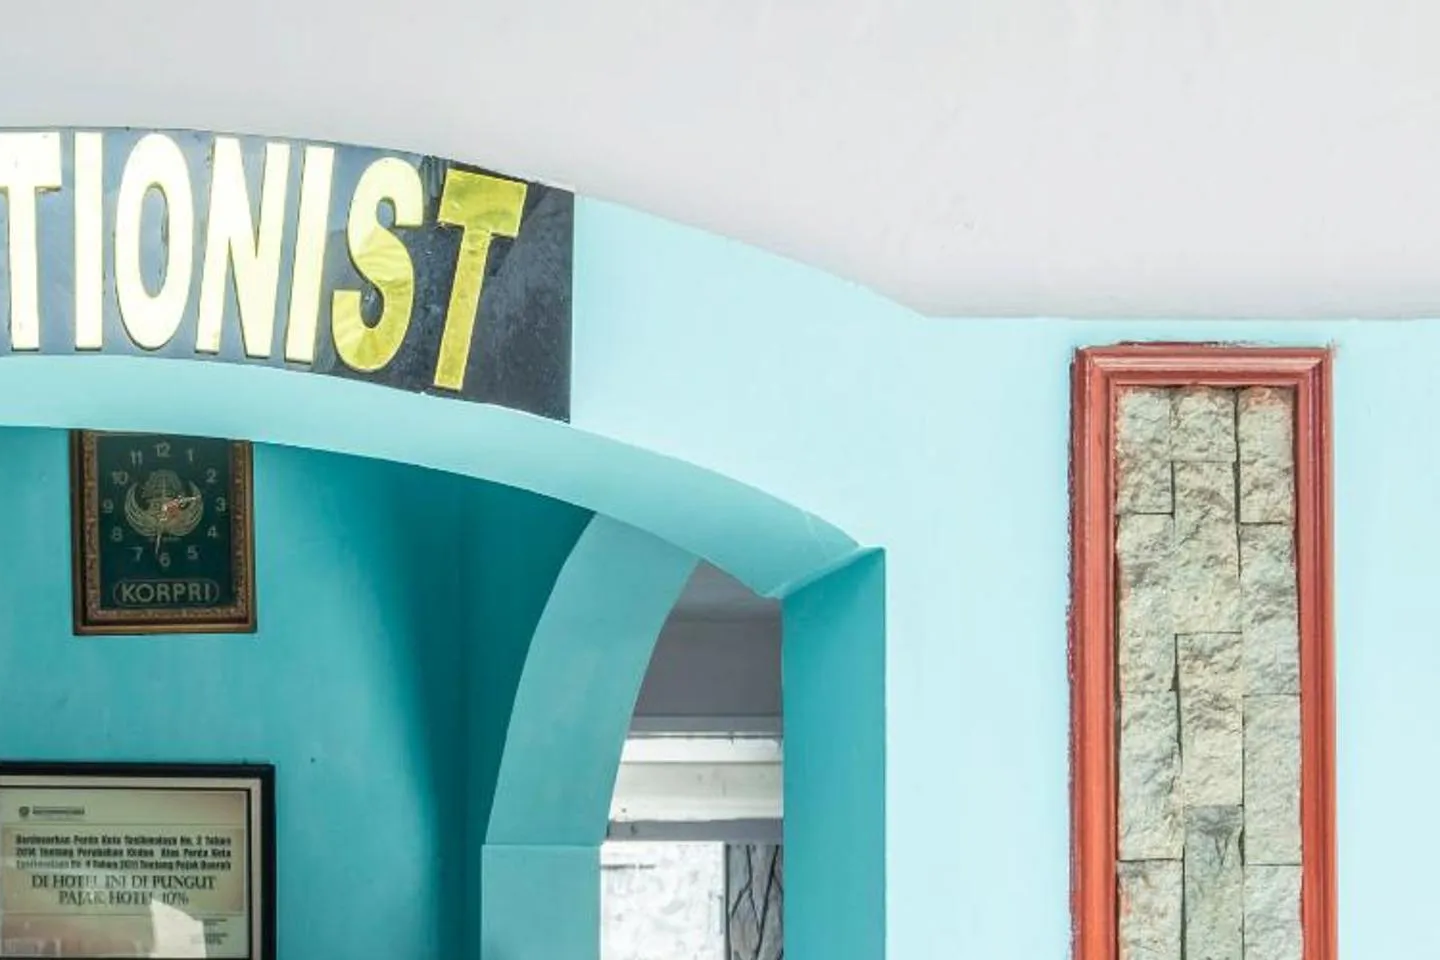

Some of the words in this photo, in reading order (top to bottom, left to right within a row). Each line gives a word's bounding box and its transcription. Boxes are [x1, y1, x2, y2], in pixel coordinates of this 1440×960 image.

[154, 442, 170, 457] 12
[186, 449, 194, 462] 1
[131, 450, 143, 466] 11
[111, 471, 129, 485] 10
[206, 469, 218, 483] 2
[102, 500, 114, 514] 9
[216, 497, 227, 512] 3
[112, 527, 123, 542] 8
[207, 525, 217, 538] 4
[131, 547, 143, 561] 7
[160, 552, 171, 567] 6
[187, 546, 199, 560] 5
[121, 583, 211, 602] KORPRI
[32, 875, 48, 888] DI
[53, 875, 100, 889] HOTEL
[105, 875, 126, 888] INI
[132, 875, 150, 888] DI
[152, 875, 217, 890] PUNGUT
[59, 891, 106, 905] PAJAK
[162, 891, 190, 905] 10%
